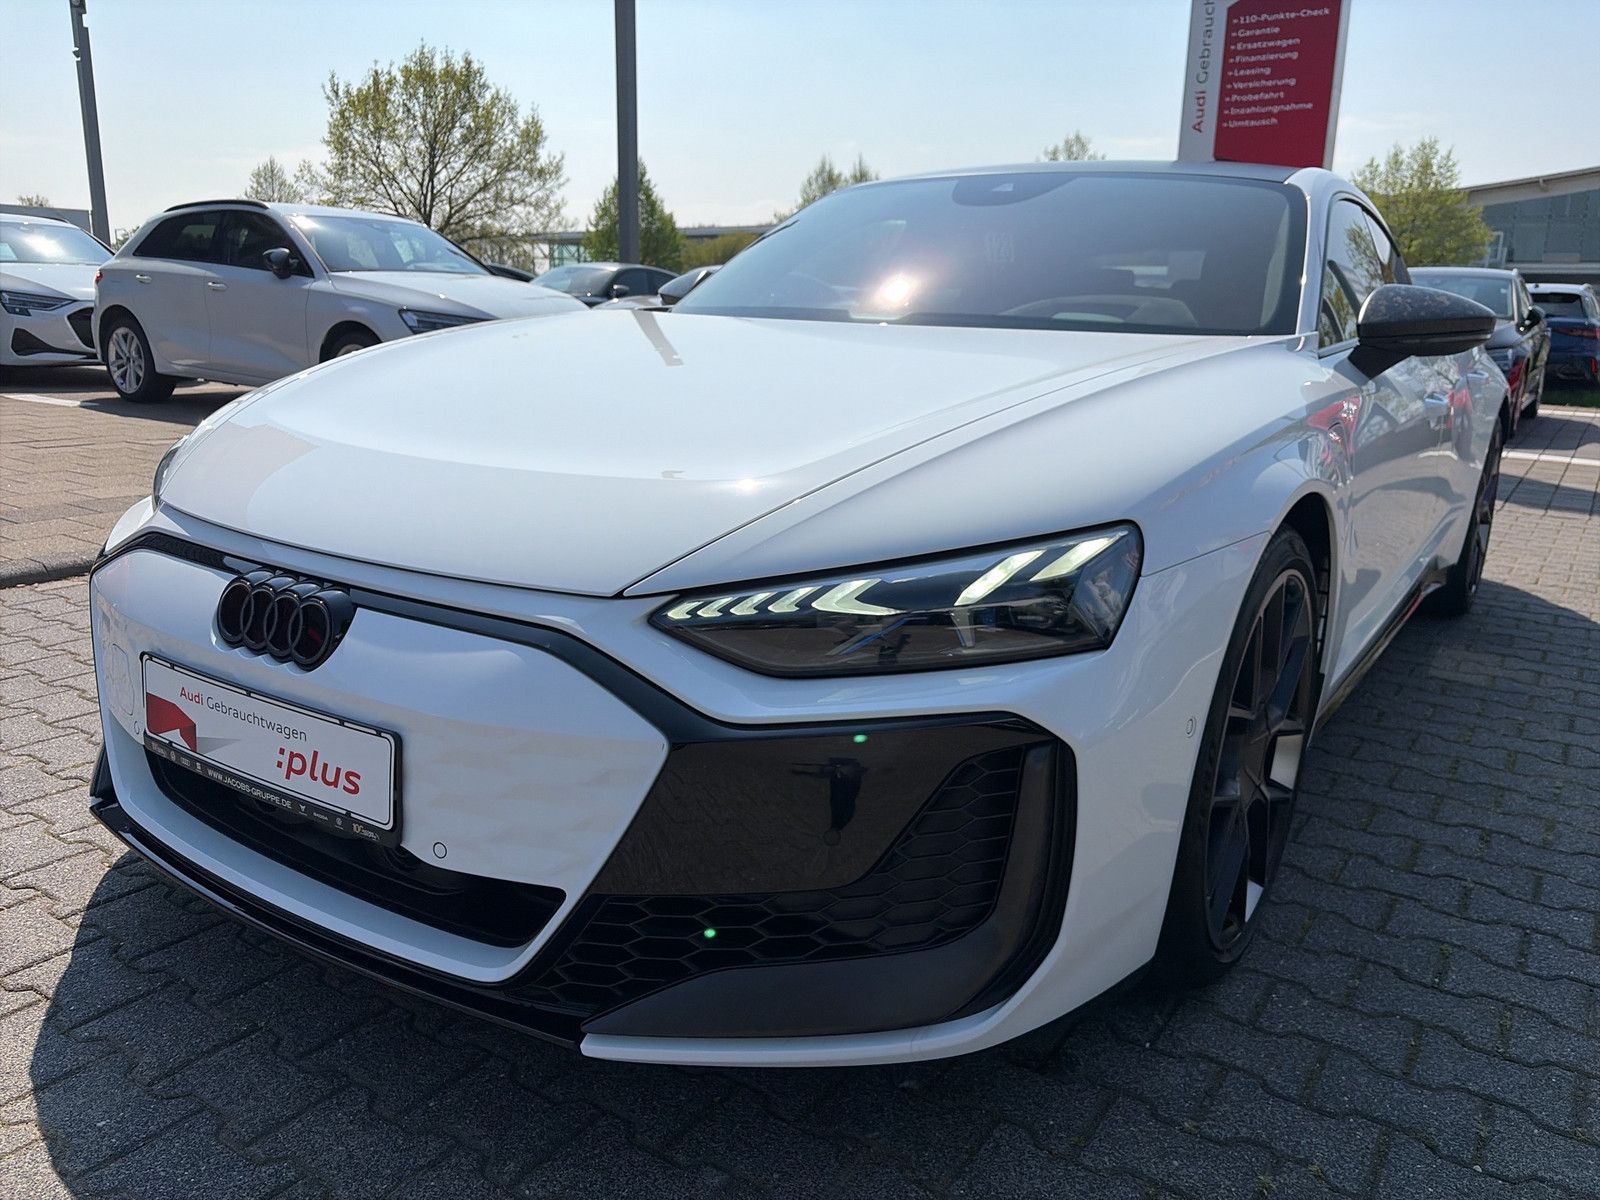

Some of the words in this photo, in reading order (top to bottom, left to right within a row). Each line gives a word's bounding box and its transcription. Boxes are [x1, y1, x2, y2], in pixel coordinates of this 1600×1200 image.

[1240, 7, 1330, 24] 110-Punkte-Check
[1238, 27, 1280, 37] Garantie
[1236, 38, 1300, 50] Ersatzwagen
[1235, 51, 1299, 63] Finanzierung
[1233, 67, 1271, 76] Leasing
[1232, 78, 1297, 89] Versicherung
[1231, 91, 1284, 102] Probefahrt
[1192, 91, 1207, 133] Audi
[1230, 102, 1313, 115] Inzahlungnahme
[1228, 117, 1278, 128] Umtausch
[179, 686, 204, 706] Audi
[206, 696, 307, 742] Gebrauchtwagen
